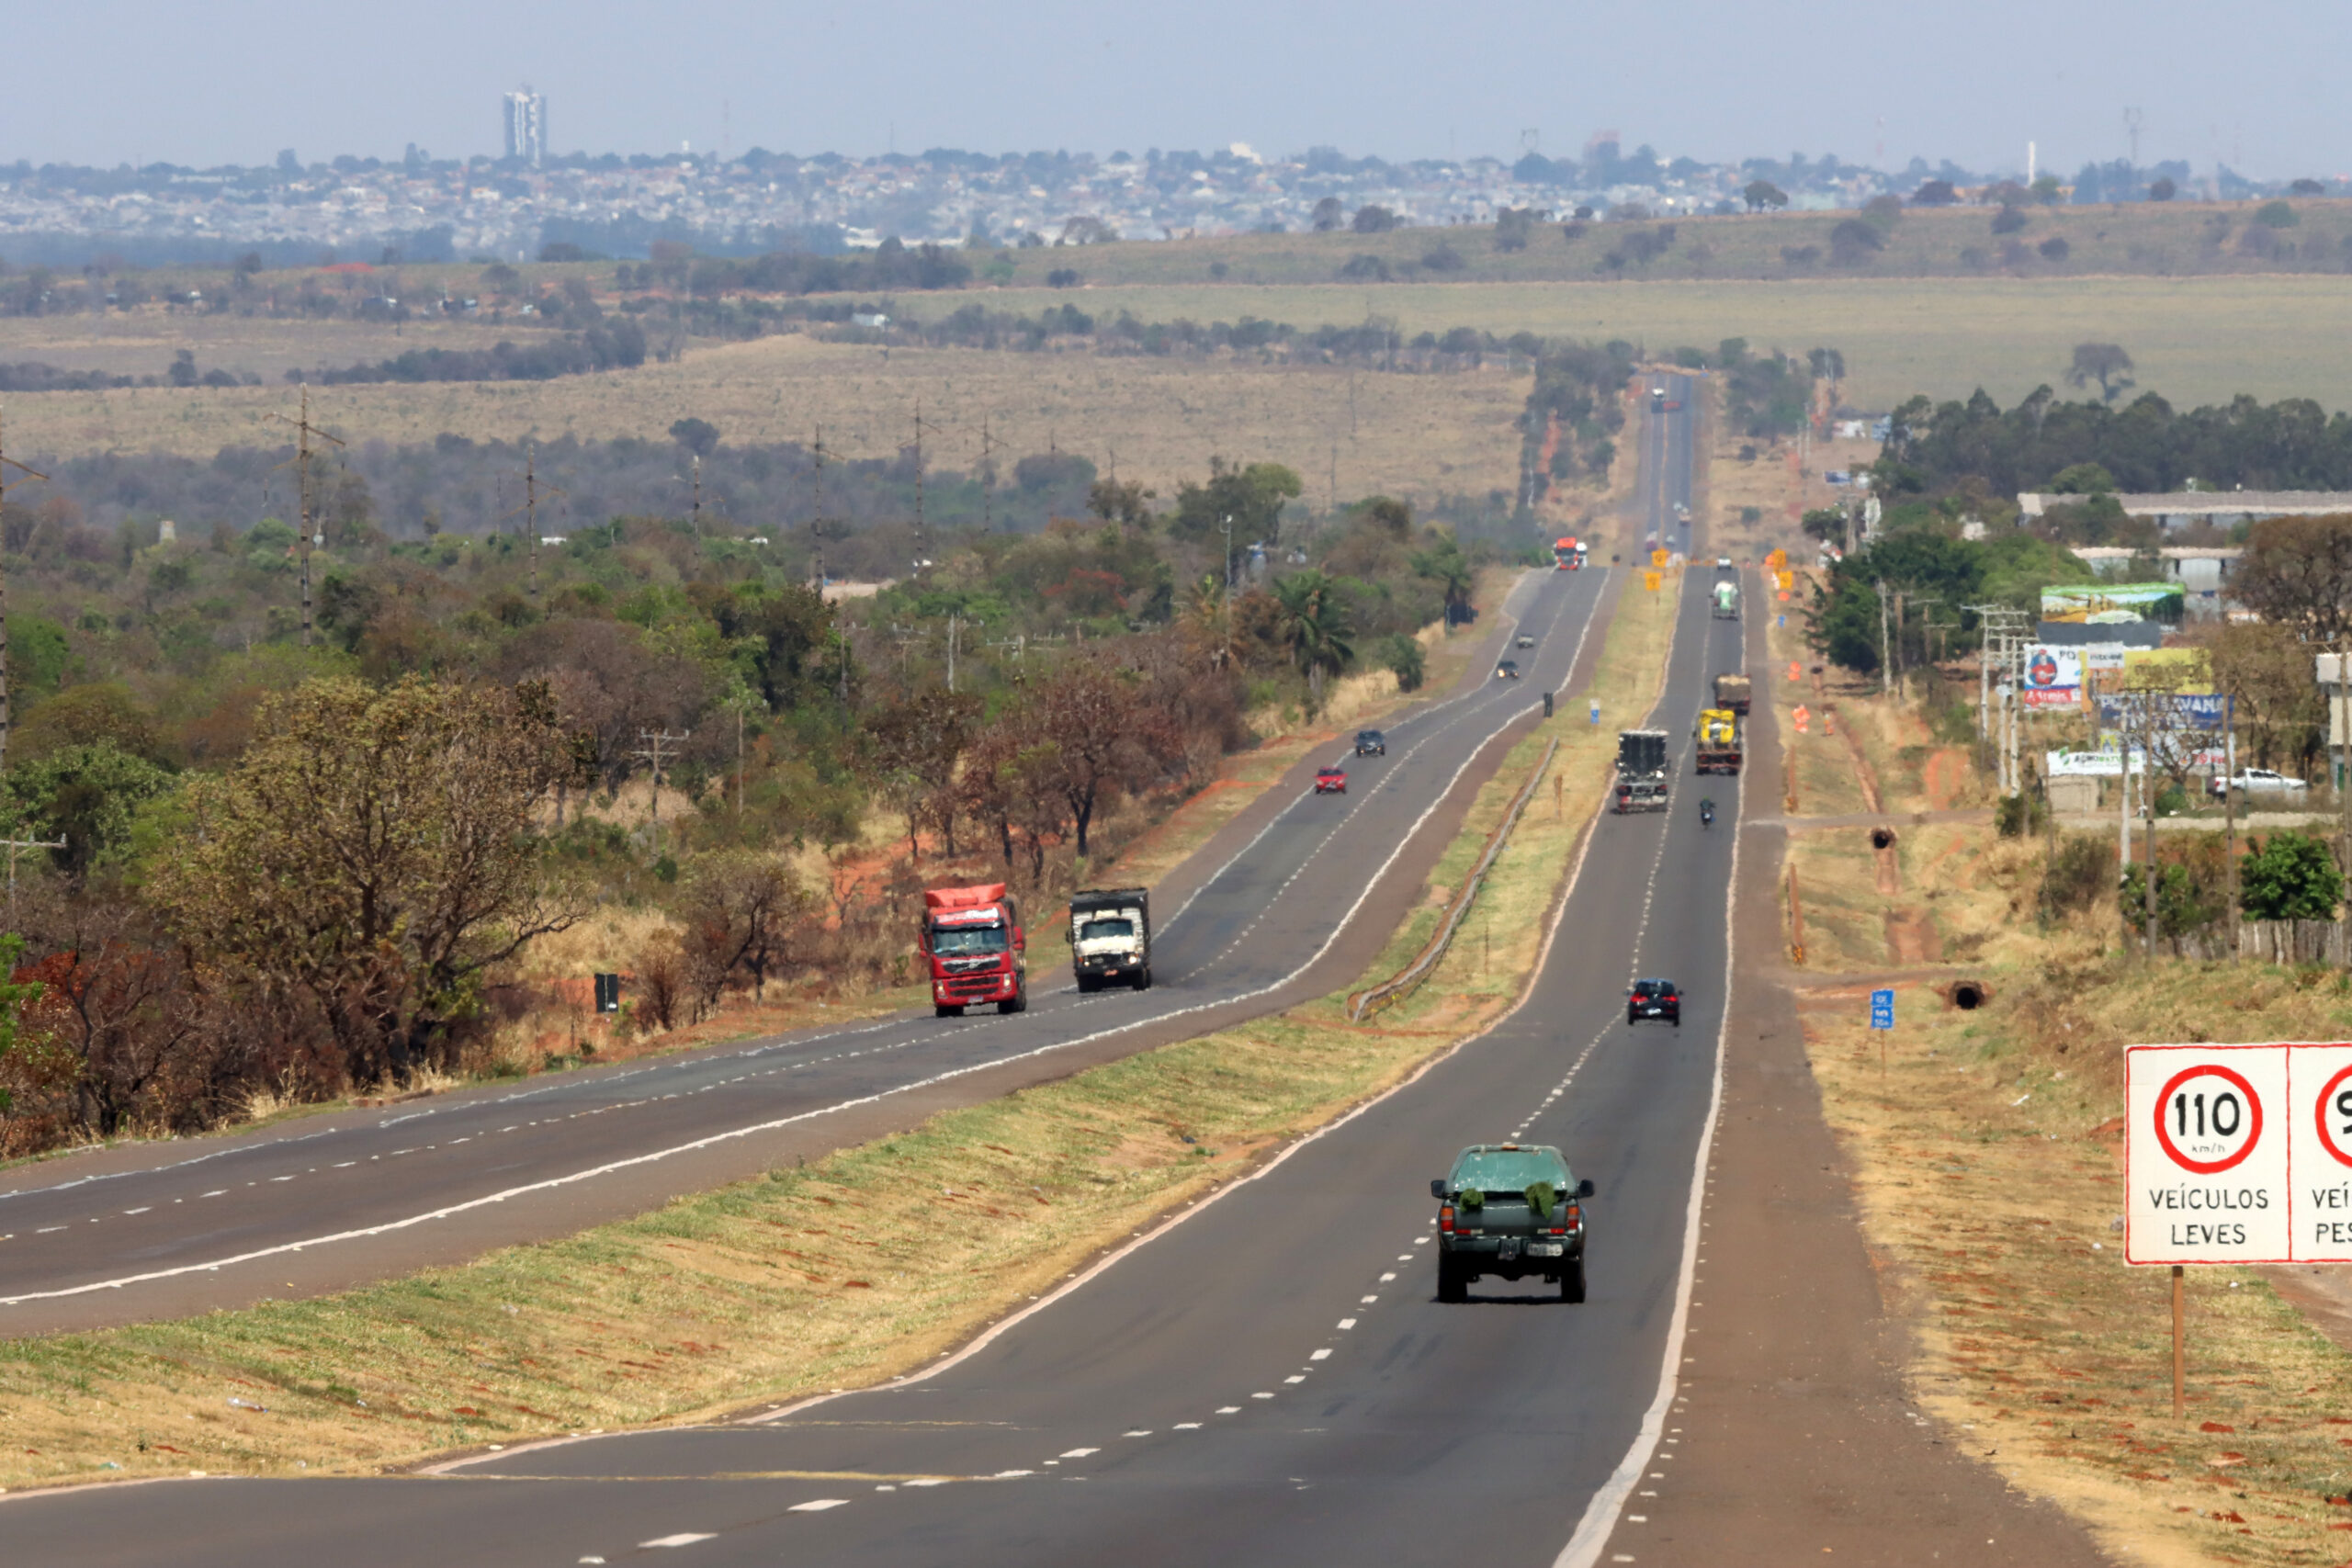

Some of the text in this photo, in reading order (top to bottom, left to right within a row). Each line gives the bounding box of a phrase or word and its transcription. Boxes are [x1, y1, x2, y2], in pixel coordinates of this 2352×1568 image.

[2175, 1092, 2240, 1136] 110
[2191, 1144, 2226, 1154] km/h
[2149, 1183, 2268, 1210] VEÍCULOS
[2171, 1224, 2246, 1246] LEVES
